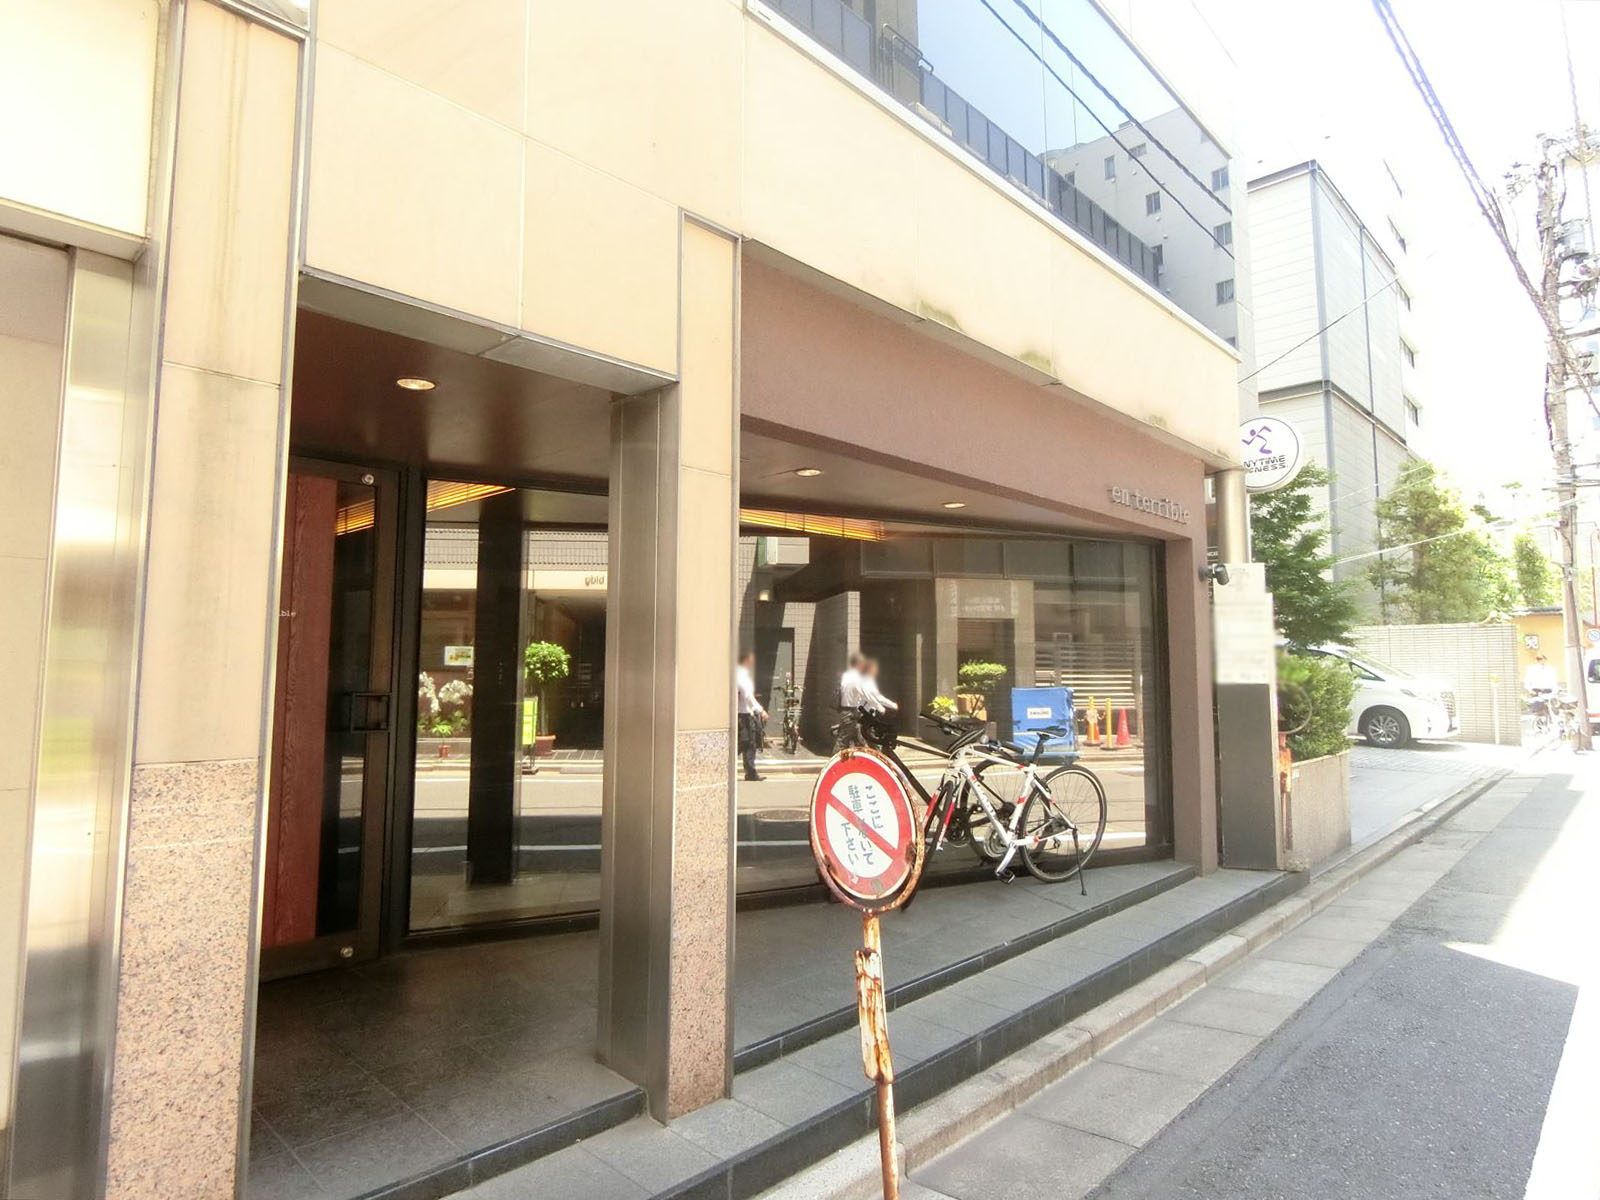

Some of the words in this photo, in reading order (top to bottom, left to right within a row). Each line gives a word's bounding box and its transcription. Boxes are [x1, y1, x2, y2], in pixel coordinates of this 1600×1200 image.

[1243, 455, 1286, 467] NYTIME
[1244, 462, 1286, 473] NESS
[1112, 486, 1129, 505] en
[866, 786, 883, 829] ここに
[842, 823, 858, 865] 下さい
